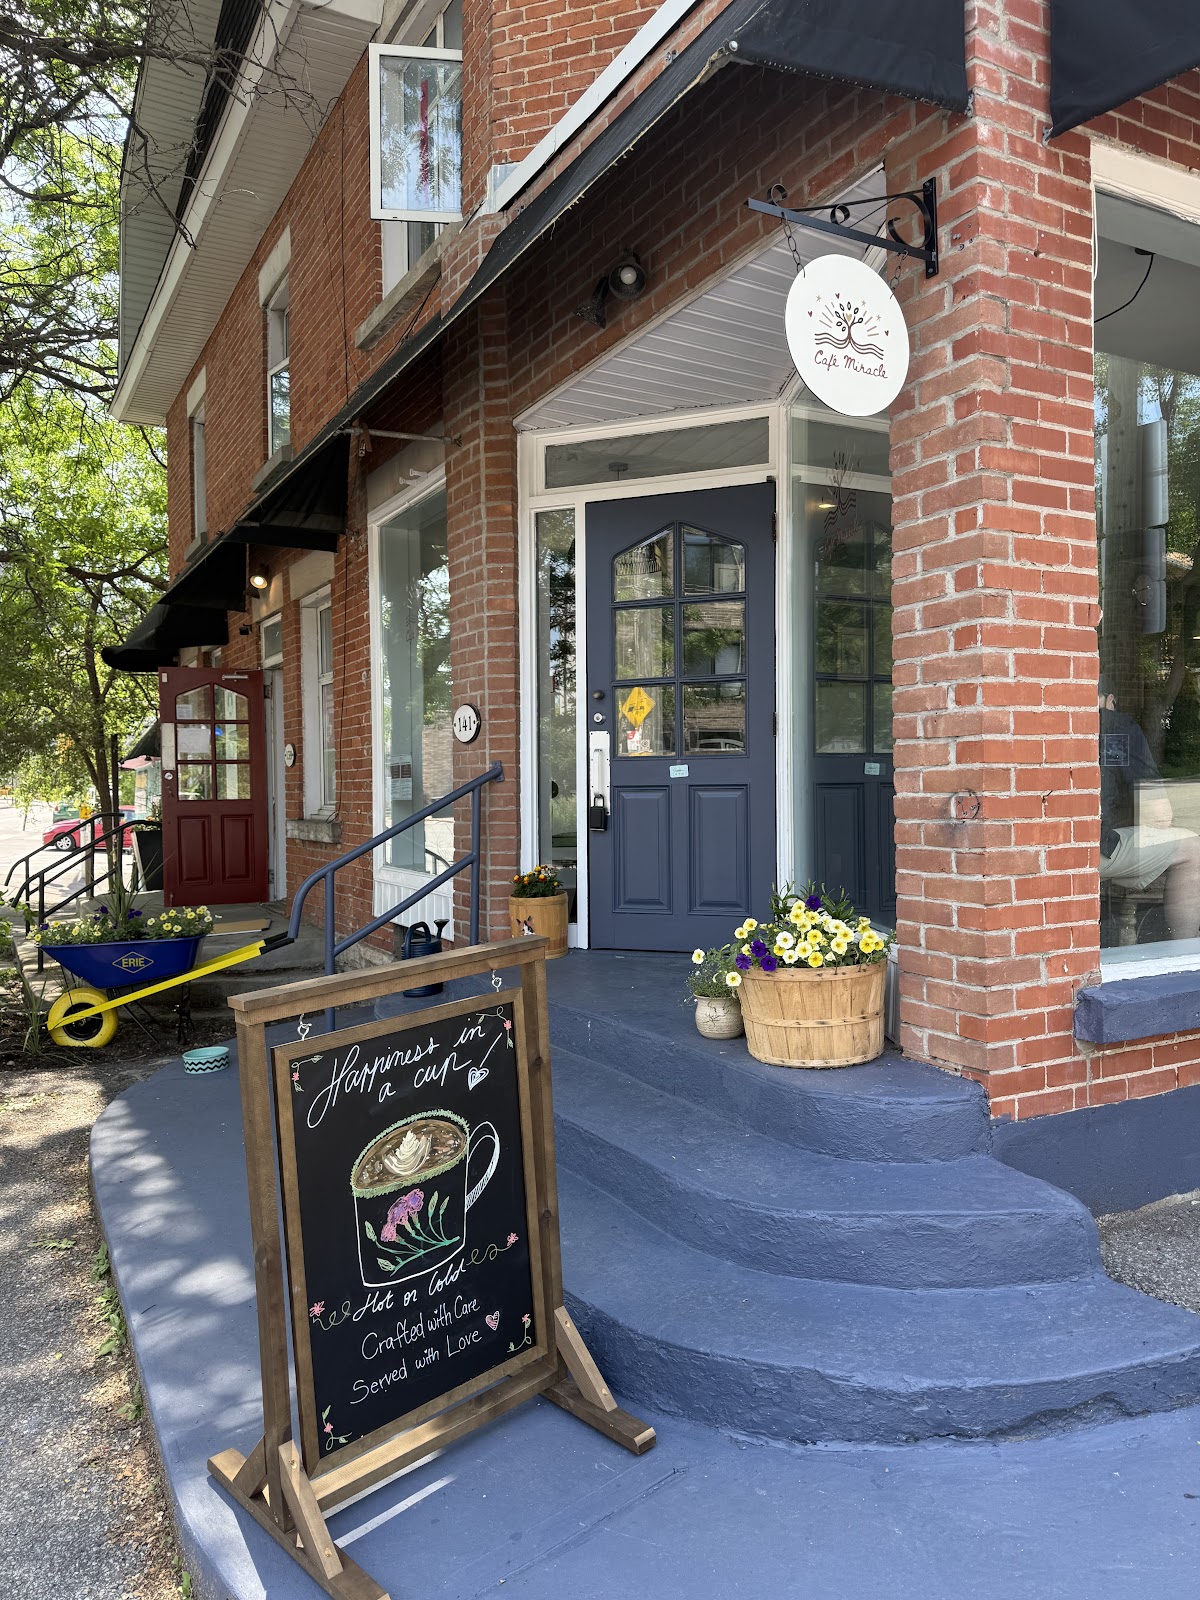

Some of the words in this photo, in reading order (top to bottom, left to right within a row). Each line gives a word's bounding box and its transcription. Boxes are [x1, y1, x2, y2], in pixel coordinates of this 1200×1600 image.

[814, 349, 839, 371] Café
[843, 354, 888, 379] Miracle
[458, 715, 472, 732] 141
[121, 957, 145, 968] ERIE
[307, 1037, 440, 1129] Happiness
[453, 1017, 486, 1048] in
[379, 1082, 396, 1103] a
[413, 1052, 473, 1087] cup
[352, 1290, 395, 1322] Hot
[403, 1289, 418, 1307] or
[428, 1258, 467, 1296] Cold
[361, 1312, 426, 1360] Crafted
[427, 1303, 453, 1332] with
[454, 1295, 481, 1320] Care
[350, 1358, 408, 1405] Served
[415, 1347, 440, 1369] with
[446, 1330, 483, 1358] Love
